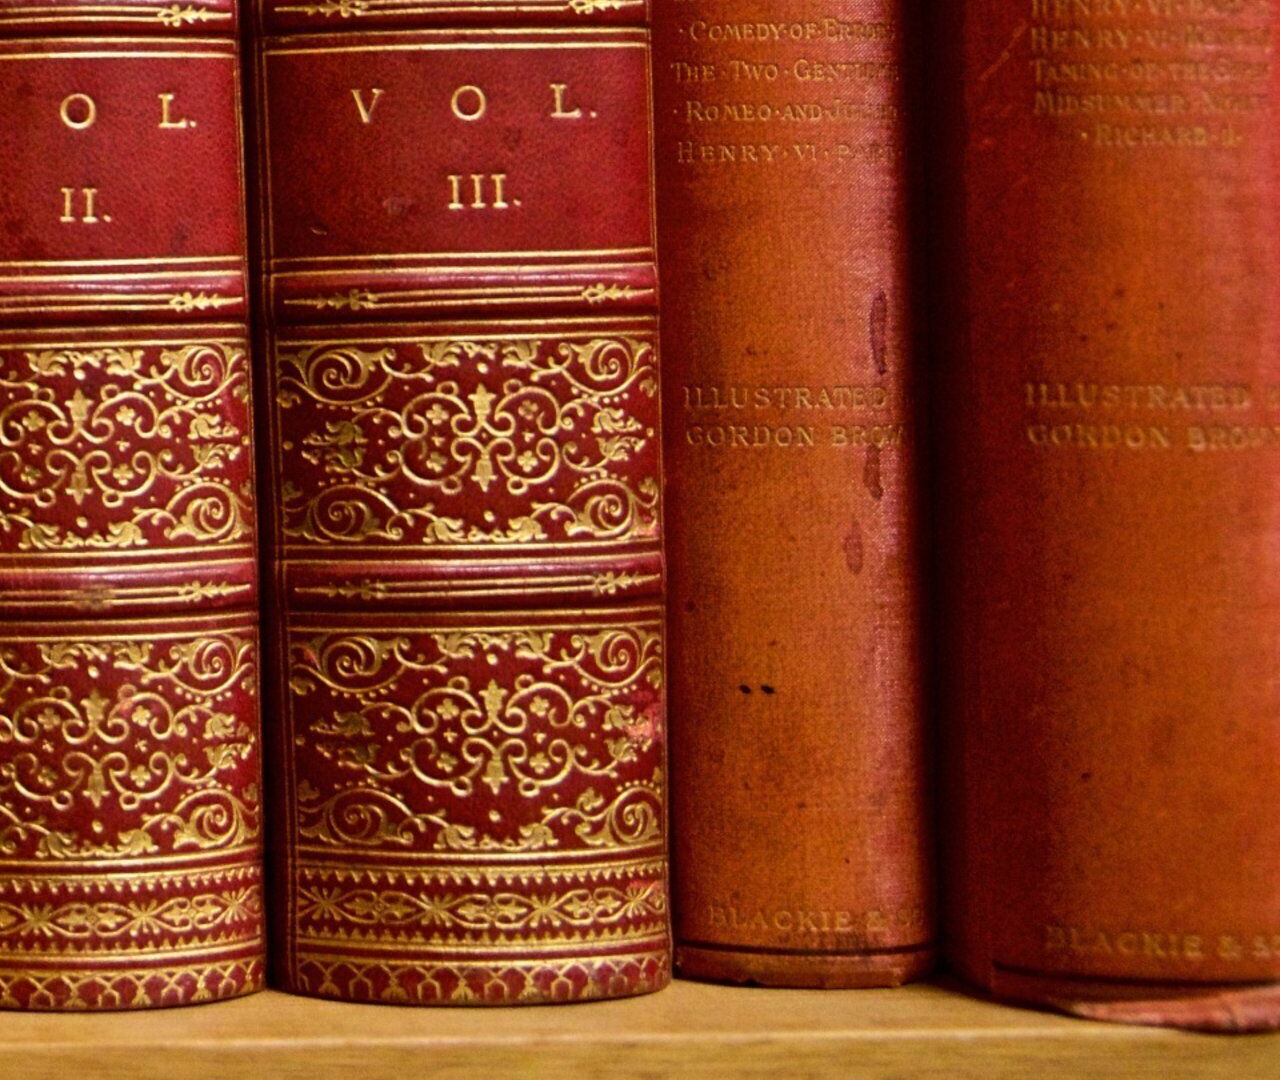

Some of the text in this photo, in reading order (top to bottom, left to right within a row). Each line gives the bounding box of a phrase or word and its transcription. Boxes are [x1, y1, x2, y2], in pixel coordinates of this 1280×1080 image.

[689, 20, 786, 42] COMEDY
[670, 62, 716, 83] THE
[728, 59, 780, 83] TWO
[685, 100, 773, 123] ROMEO
[780, 103, 823, 123] AND
[677, 141, 781, 164] HENRY
[446, 173, 522, 210] III.
[59, 186, 112, 224] II.
[682, 385, 888, 410] ILLUSTRATED
[1024, 382, 1253, 411] ILLUSTRATED
[685, 424, 816, 449] GORDON
[1027, 423, 1172, 449] GORDON
[708, 906, 853, 933] BLACKIE
[1044, 924, 1204, 959] BLACKIE
